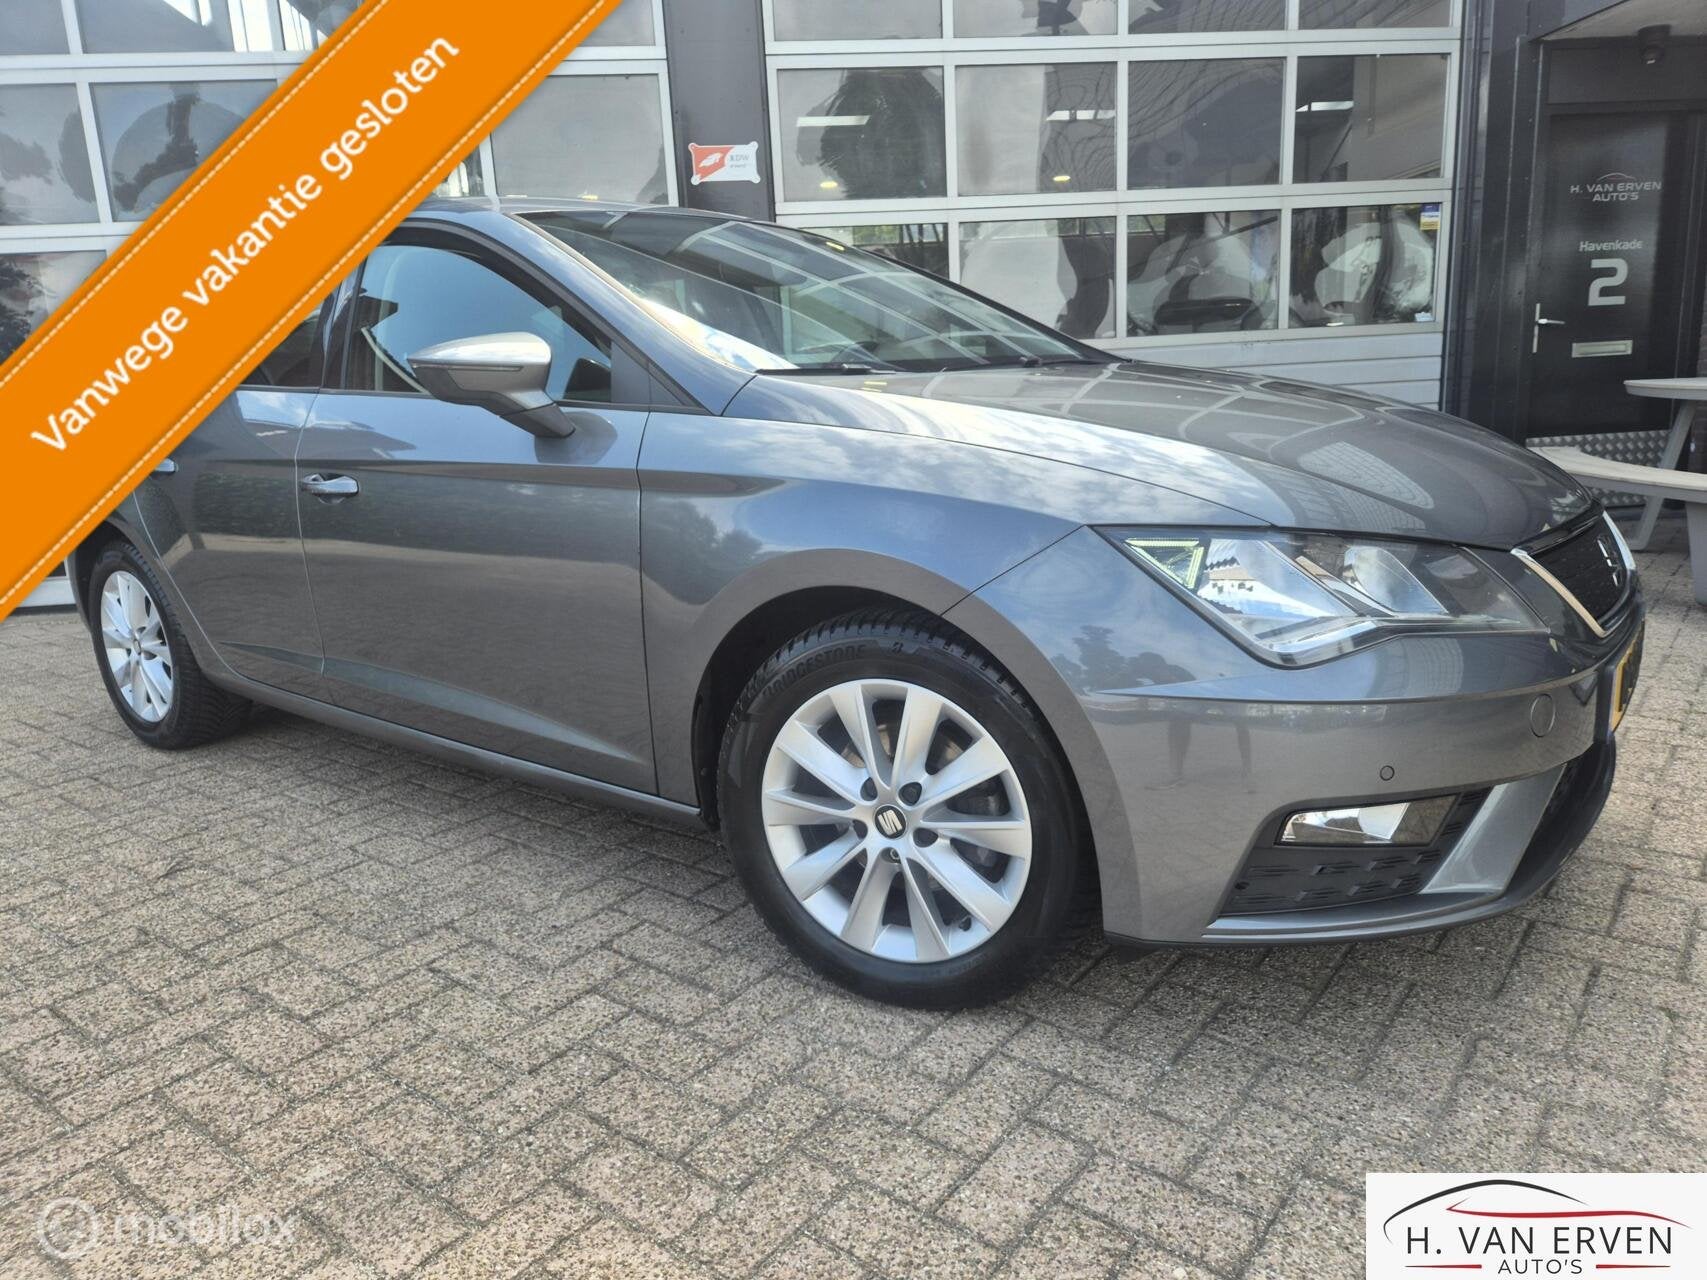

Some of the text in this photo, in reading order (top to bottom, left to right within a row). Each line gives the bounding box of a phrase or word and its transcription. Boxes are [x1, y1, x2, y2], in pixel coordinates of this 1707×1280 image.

[1570, 181, 1663, 194] H. VAN ERVEN
[1592, 191, 1640, 202] AUTO'S
[1579, 239, 1644, 252] Havenkade
[1588, 258, 1628, 306] 2
